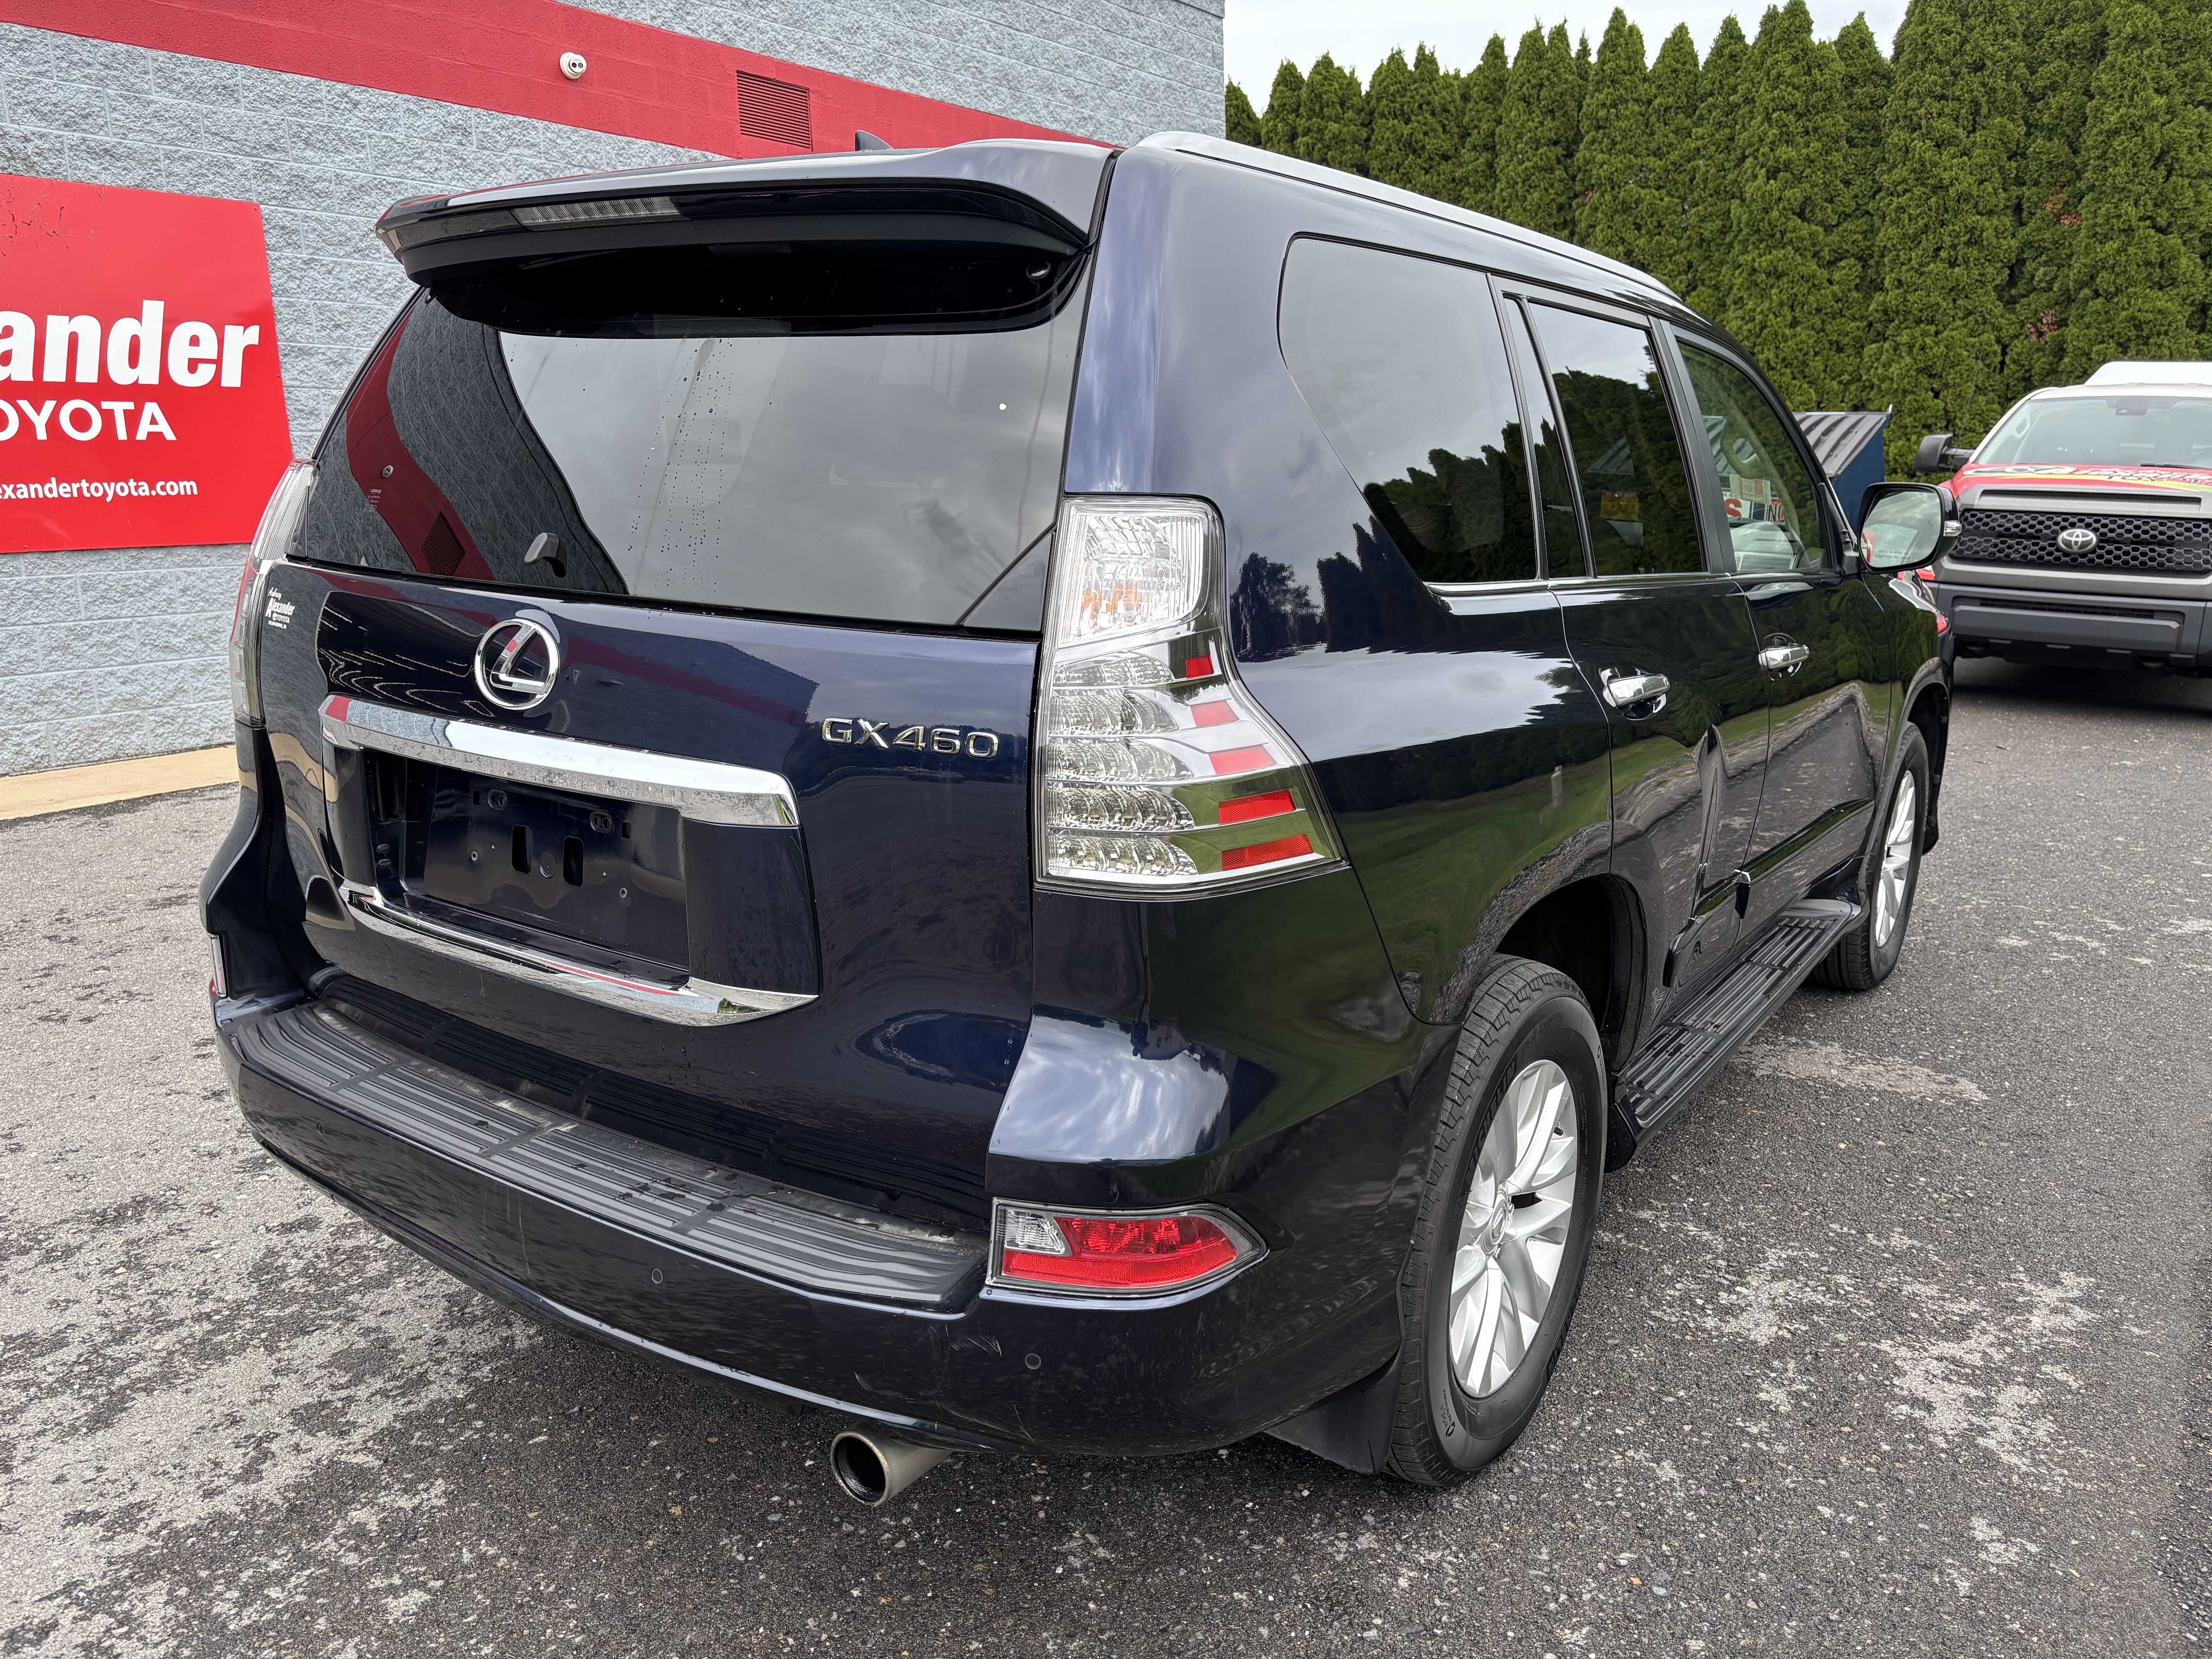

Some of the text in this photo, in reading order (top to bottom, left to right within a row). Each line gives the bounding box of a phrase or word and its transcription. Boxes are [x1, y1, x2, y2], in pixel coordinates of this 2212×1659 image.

[0, 299, 259, 387] ander
[0, 477, 198, 502] xandertoyota.com
[265, 598, 295, 617] Alexander
[276, 614, 290, 623] TOYOTA
[1440, 1403, 1449, 1428] MICHELIN
